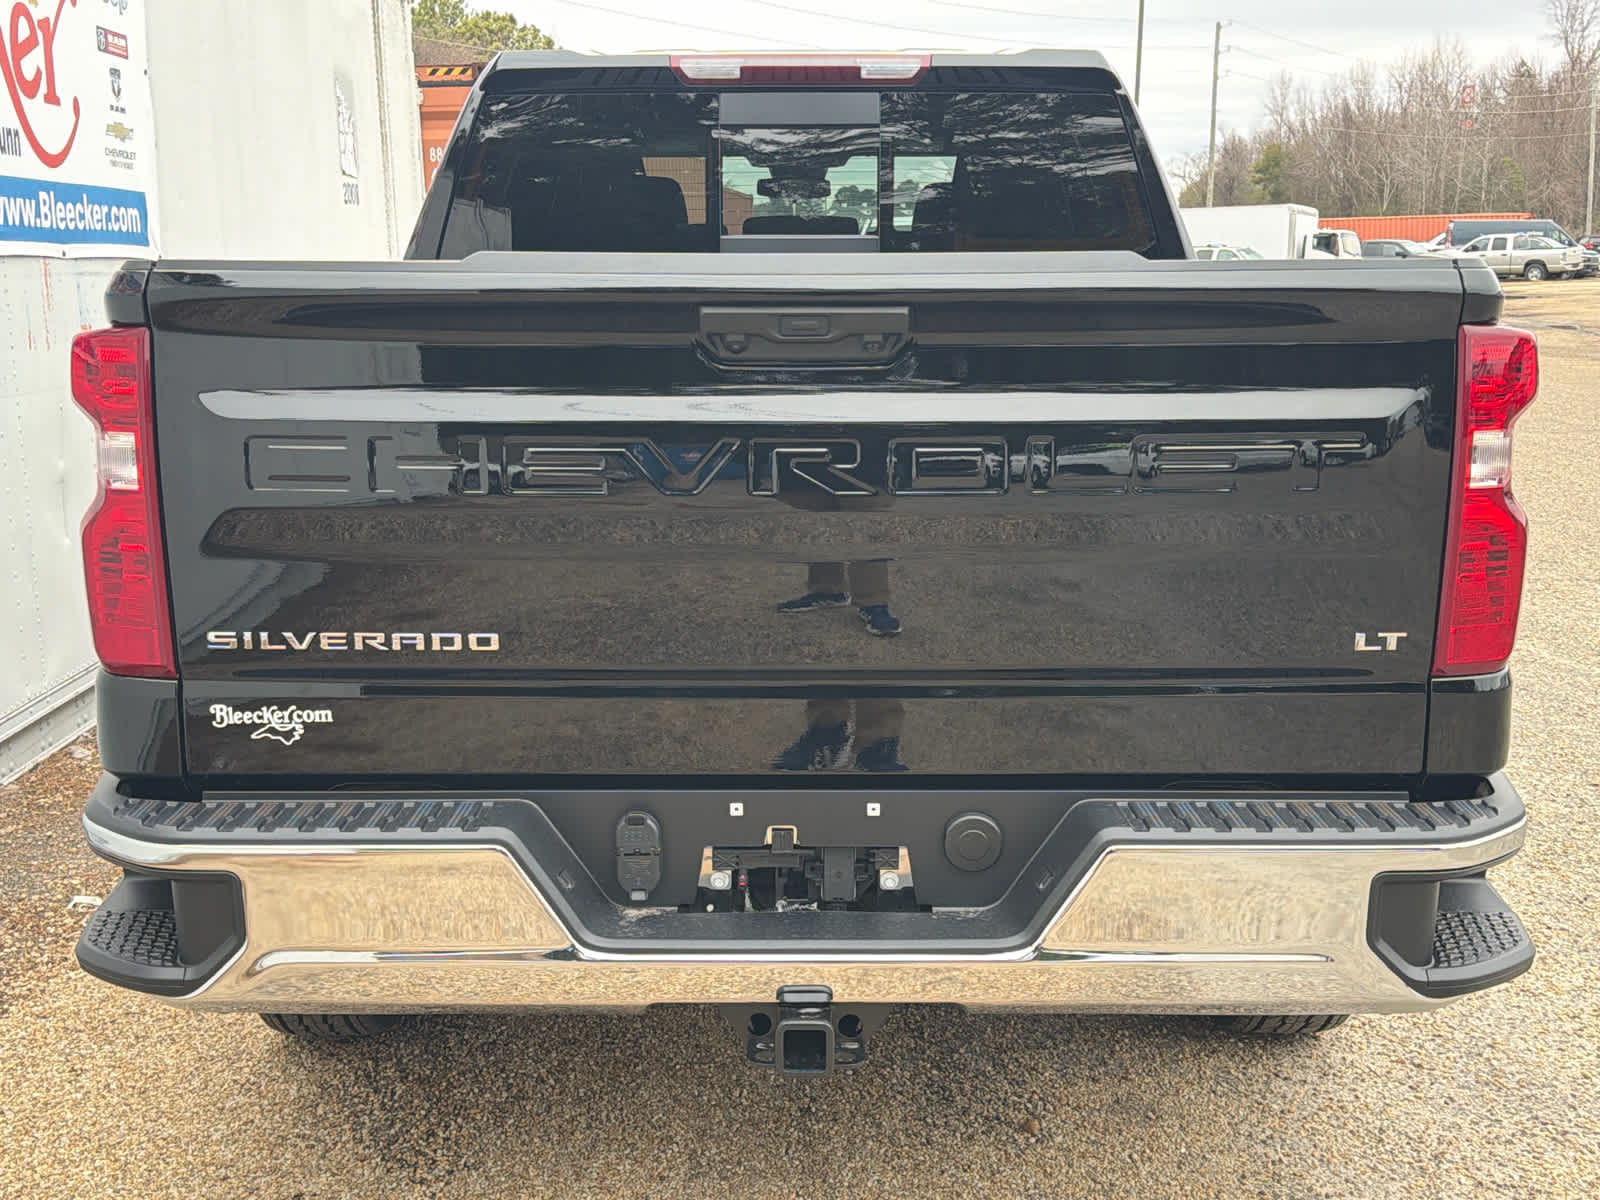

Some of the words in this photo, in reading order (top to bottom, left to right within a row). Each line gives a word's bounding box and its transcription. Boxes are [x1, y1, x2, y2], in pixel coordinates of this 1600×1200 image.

[0, 190, 142, 234] ww.Bleecker.com
[244, 433, 1368, 498] CHEVROLET
[206, 631, 500, 652] SILVERADO
[1354, 631, 1408, 651] LT
